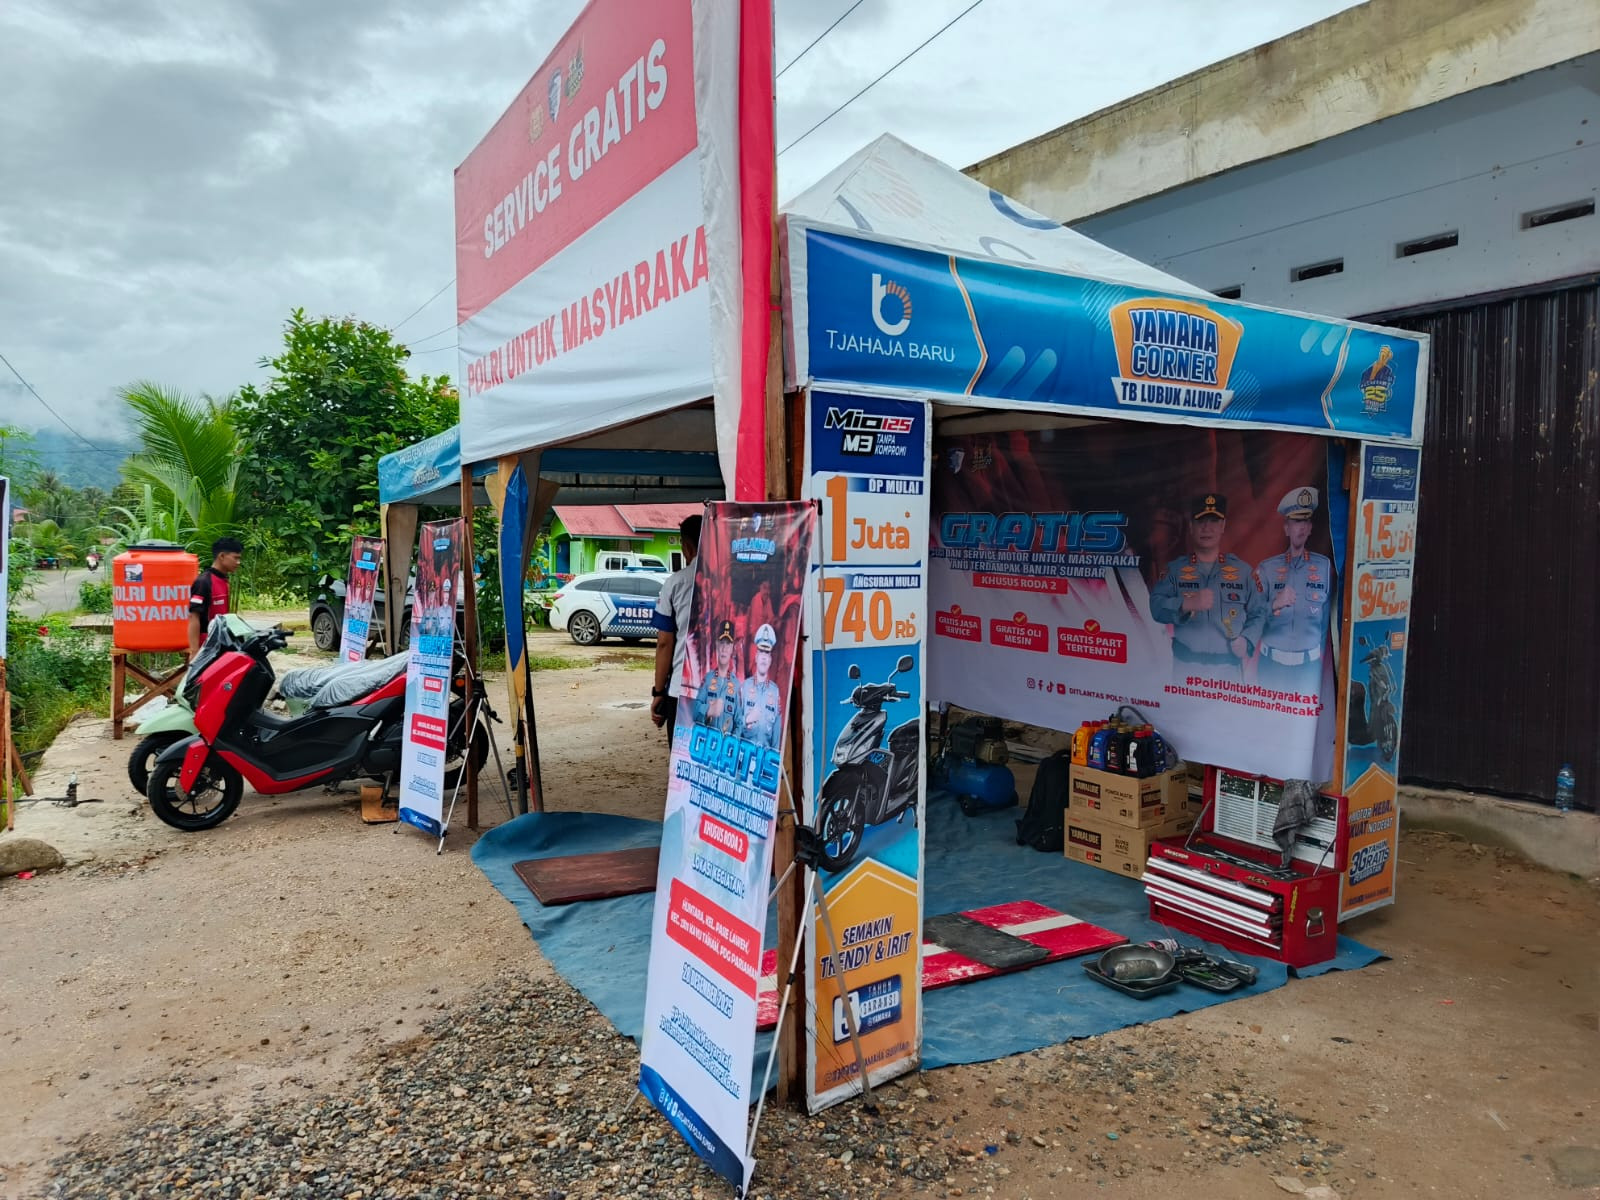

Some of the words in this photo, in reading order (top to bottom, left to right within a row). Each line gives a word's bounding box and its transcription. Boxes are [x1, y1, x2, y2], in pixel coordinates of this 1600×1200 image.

[484, 143, 562, 259] SERVICE
[566, 38, 668, 181] GRATIS
[1129, 308, 1219, 352] YAMAHA
[466, 350, 503, 398] POLRI
[506, 314, 557, 380] UNTUK
[826, 329, 906, 359] TJAHAJA
[907, 342, 956, 364] BARU
[1131, 344, 1219, 384] CORNER
[1120, 381, 1137, 403] TB
[1139, 384, 1181, 408] LUBUK
[1183, 388, 1223, 411] ALUNG
[874, 444, 907, 457] KOMPROMI
[876, 434, 896, 445] TANPA
[868, 478, 885, 493] DP
[886, 480, 920, 495] MULAI
[826, 474, 848, 562] 1
[851, 517, 911, 550] Juta
[940, 511, 1129, 554] GRATIS
[963, 550, 997, 561] SERVICE
[998, 551, 1030, 563] MOTOR
[1032, 553, 1066, 564] UNTUK
[1068, 555, 1141, 567] MASYARAKAT
[971, 561, 1022, 573] TERDAMPAK
[1023, 564, 1058, 576] BANJIR
[1059, 565, 1106, 578] SUMBAR
[853, 574, 894, 588] ANGSURAN
[895, 575, 919, 588] MULAI
[980, 576, 1018, 590] KHUSUS
[1019, 579, 1048, 591] RODA
[1049, 580, 1058, 592] 2
[617, 607, 654, 619] POLISI
[818, 576, 893, 645] 740
[959, 621, 978, 630] JASA
[995, 625, 1026, 637] GRATIS
[1027, 629, 1042, 638] OLI
[1004, 635, 1032, 646] MESIN
[1060, 633, 1095, 646] GRATIS
[1095, 637, 1123, 648] PART
[1065, 643, 1117, 658] TERTENTU
[1069, 687, 1105, 700] DITLANTAS
[1130, 697, 1160, 709] SUMBAR
[1186, 676, 1319, 704] #PolriUntukMasyarakat
[689, 721, 780, 794] GRATIS
[703, 820, 724, 843] KHUSUS
[724, 829, 739, 850] RODA
[738, 838, 744, 854] 2
[841, 915, 894, 947] SEMAKIN
[875, 940, 885, 961] &
[887, 931, 913, 958] IRIT
[863, 993, 897, 1015] GARANSI
